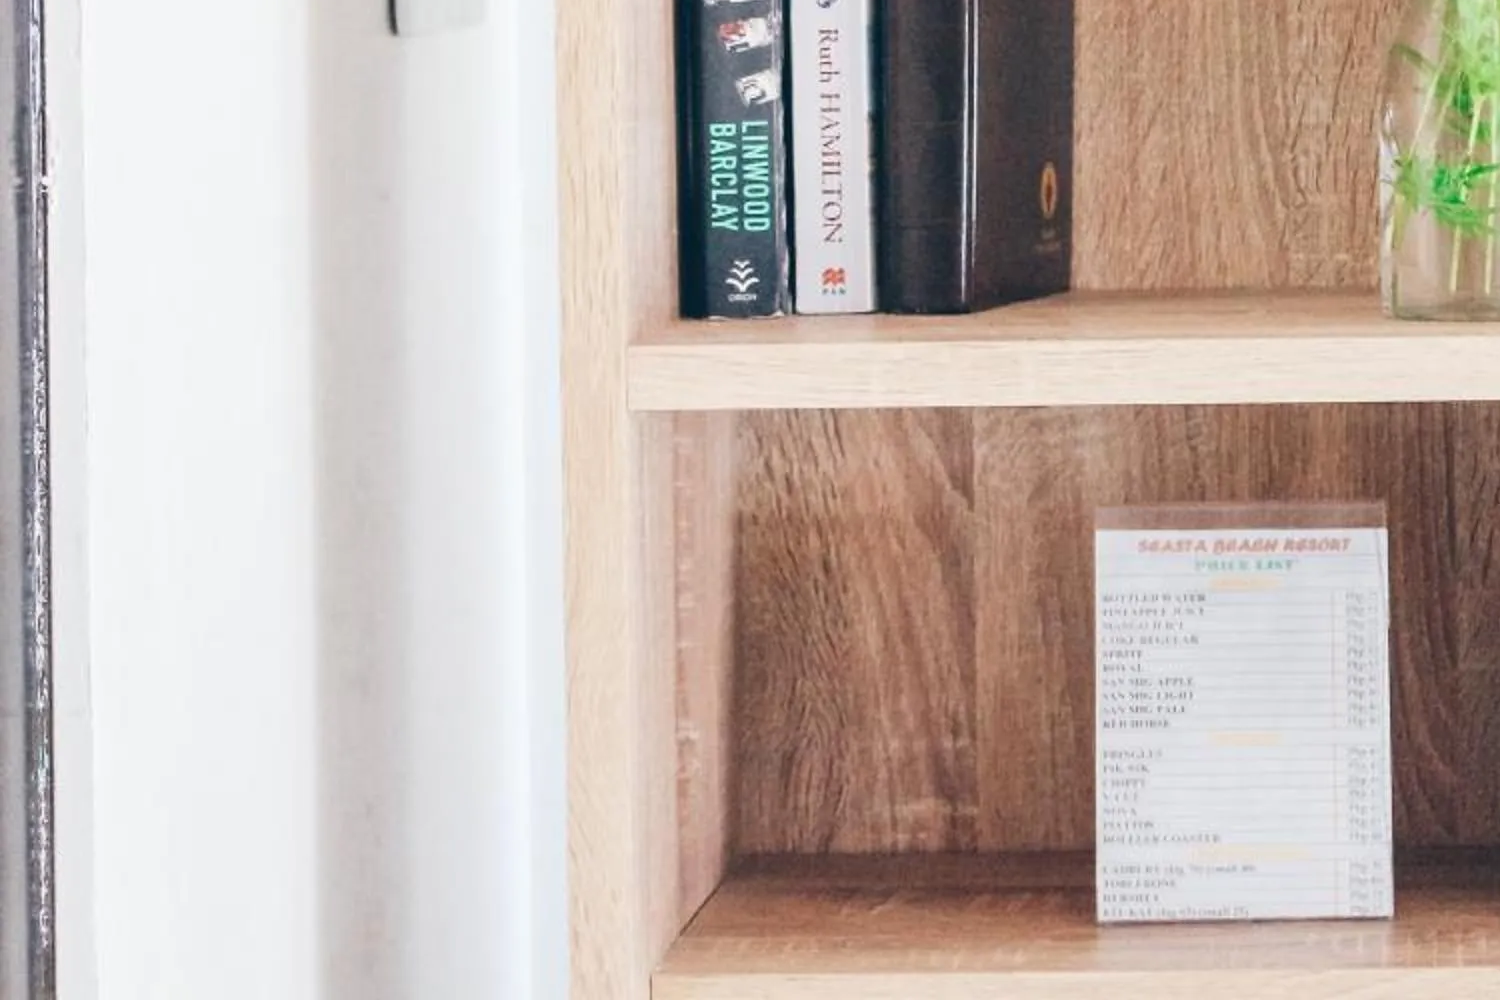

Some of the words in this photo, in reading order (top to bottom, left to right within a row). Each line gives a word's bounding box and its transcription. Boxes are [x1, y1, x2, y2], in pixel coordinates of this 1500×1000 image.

[818, 29, 841, 83] Ruth
[709, 122, 739, 232] BARCLAY
[741, 119, 771, 232] LINWOOD
[820, 93, 844, 244] HAMILTON
